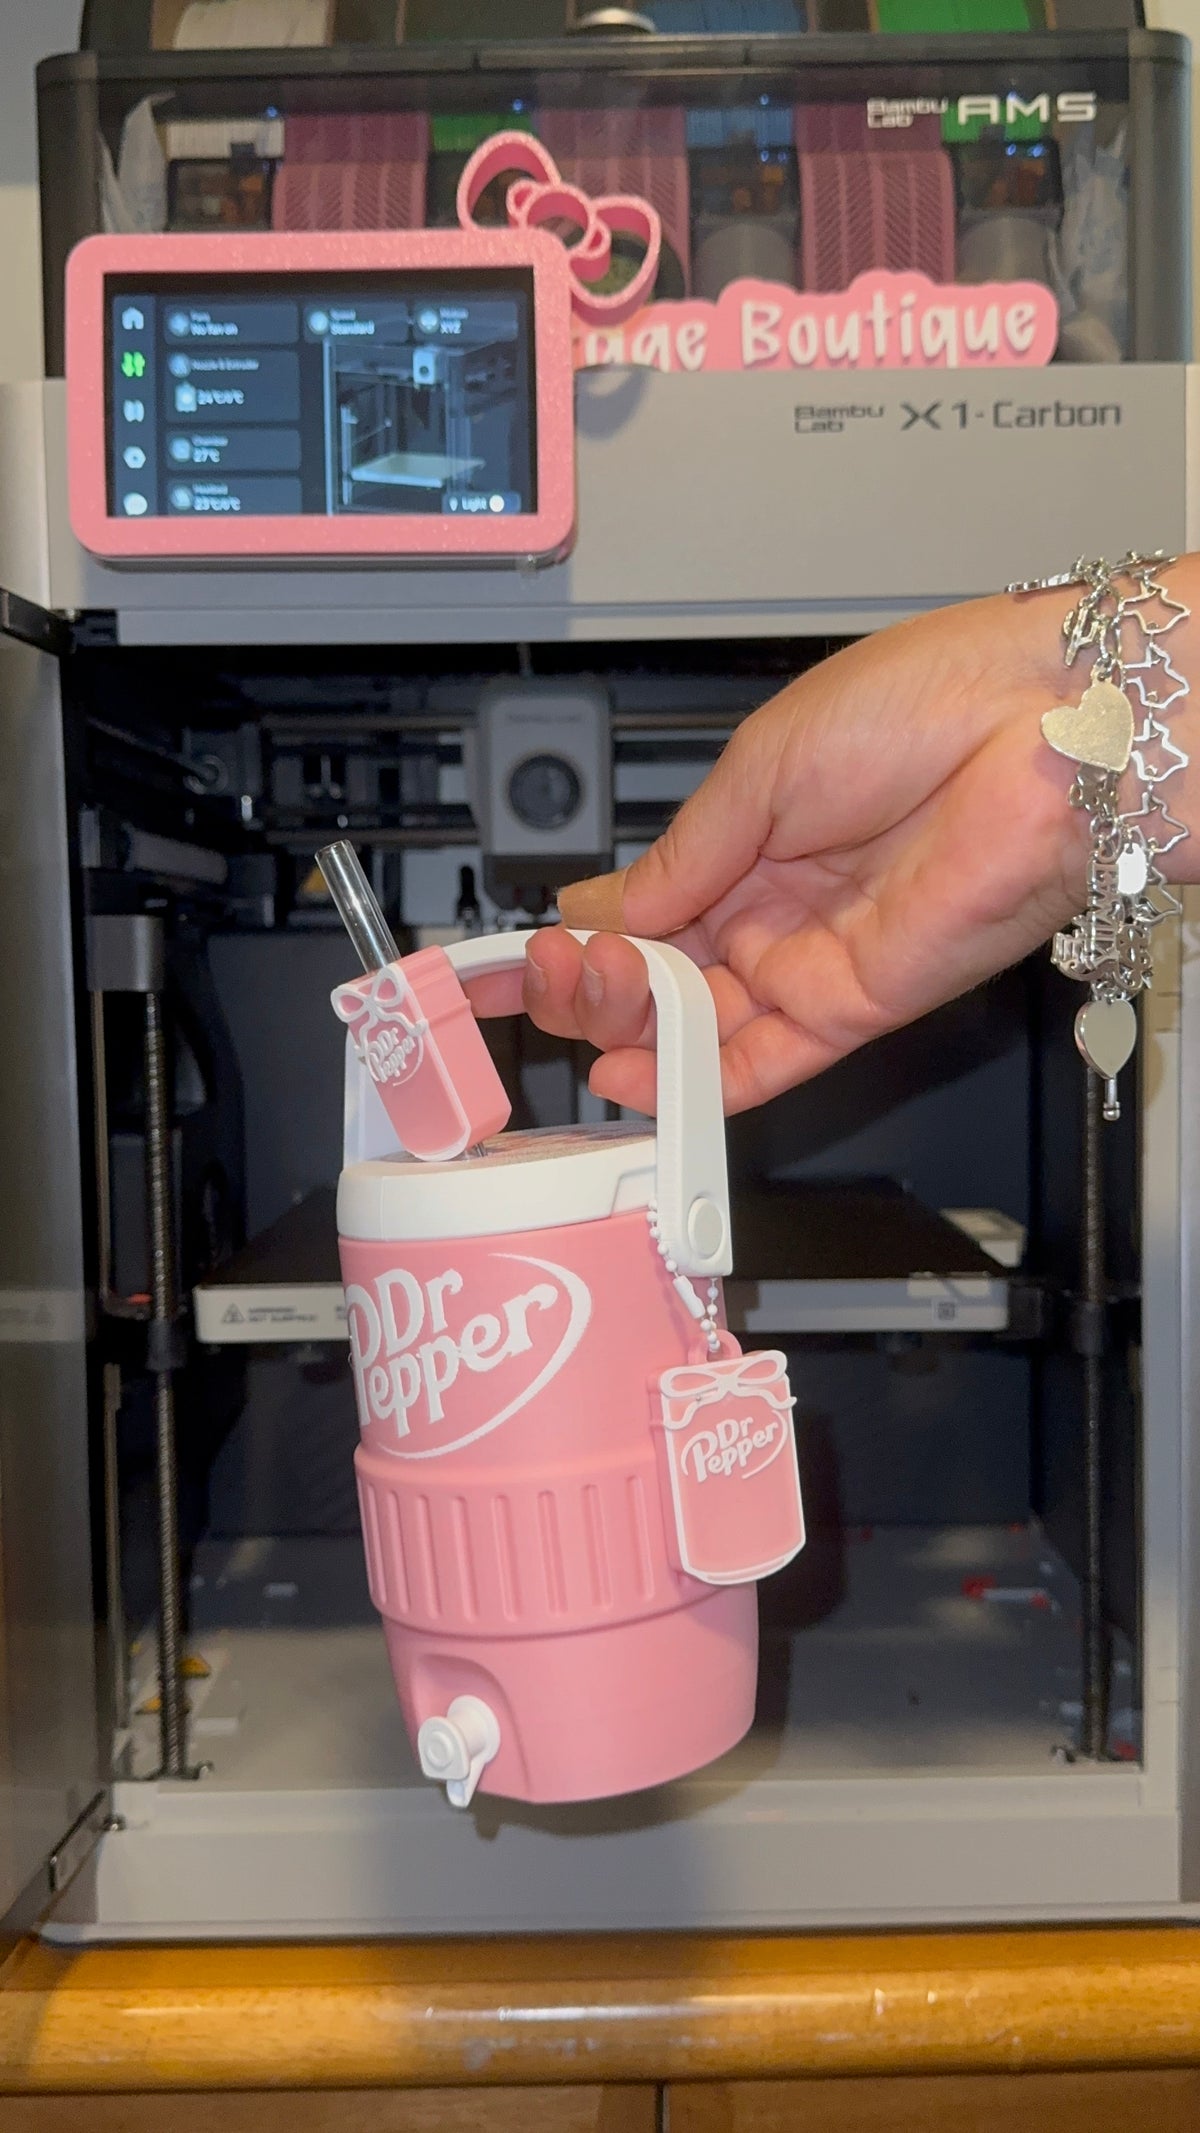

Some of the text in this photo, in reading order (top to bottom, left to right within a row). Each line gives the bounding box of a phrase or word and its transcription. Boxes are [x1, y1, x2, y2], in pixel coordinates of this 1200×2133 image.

[867, 97, 949, 114] Bambu
[867, 114, 914, 128] Lab
[958, 91, 1097, 125] AMS
[741, 290, 1037, 368] Boutique
[794, 405, 885, 418] Bambu
[795, 420, 845, 434] Lab
[461, 496, 487, 512] Light
[376, 1027, 399, 1056] Dr
[369, 1036, 417, 1083] Pepper
[374, 1268, 463, 1357] Dr
[345, 1283, 558, 1438] Pepper
[716, 1416, 754, 1449] Dr
[690, 1422, 779, 1483] Pepper
